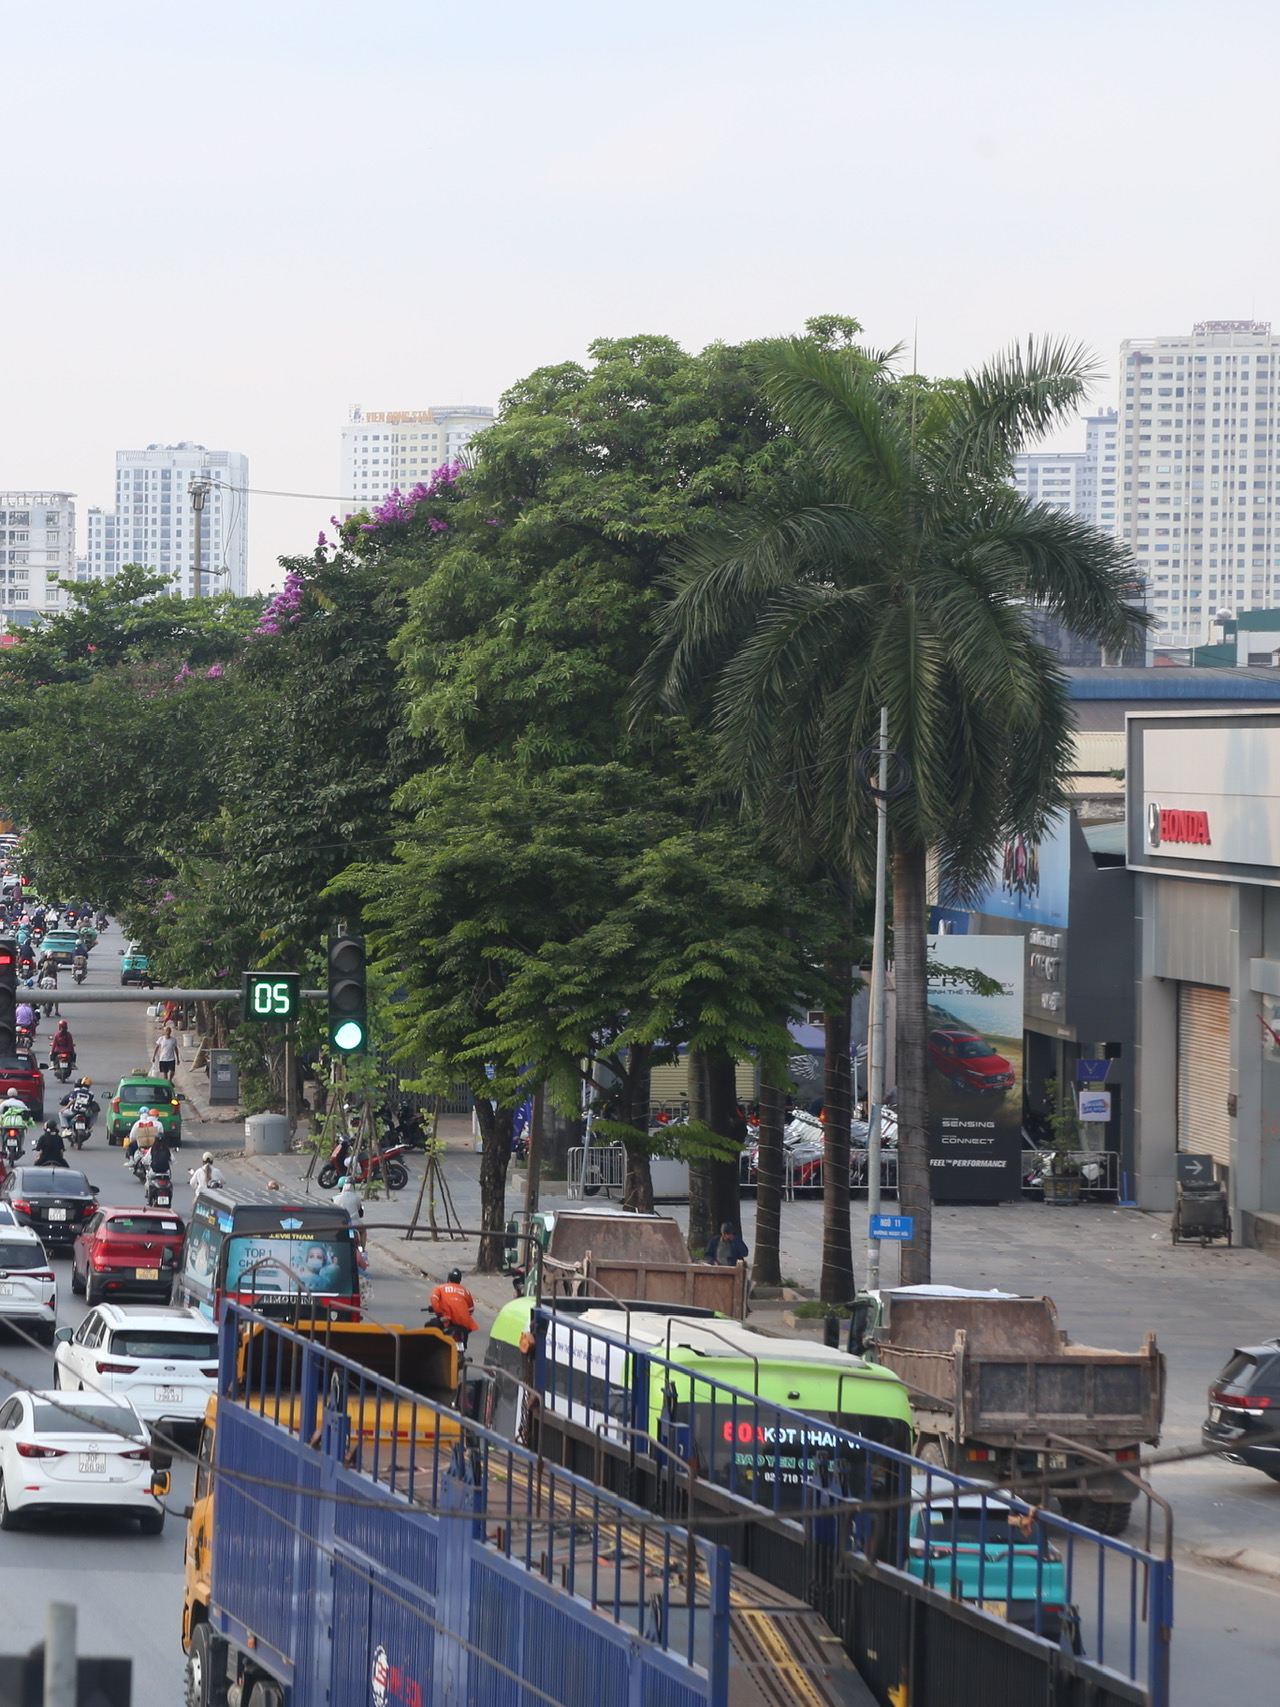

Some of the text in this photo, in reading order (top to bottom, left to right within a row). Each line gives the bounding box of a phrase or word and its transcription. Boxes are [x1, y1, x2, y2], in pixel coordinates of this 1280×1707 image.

[1160, 808, 1210, 845] HONDA
[253, 982, 290, 1014] 05
[930, 1159, 945, 1167] FEEL
[952, 1160, 1007, 1168] PERFORMANCE
[245, 1247, 266, 1258] TOP
